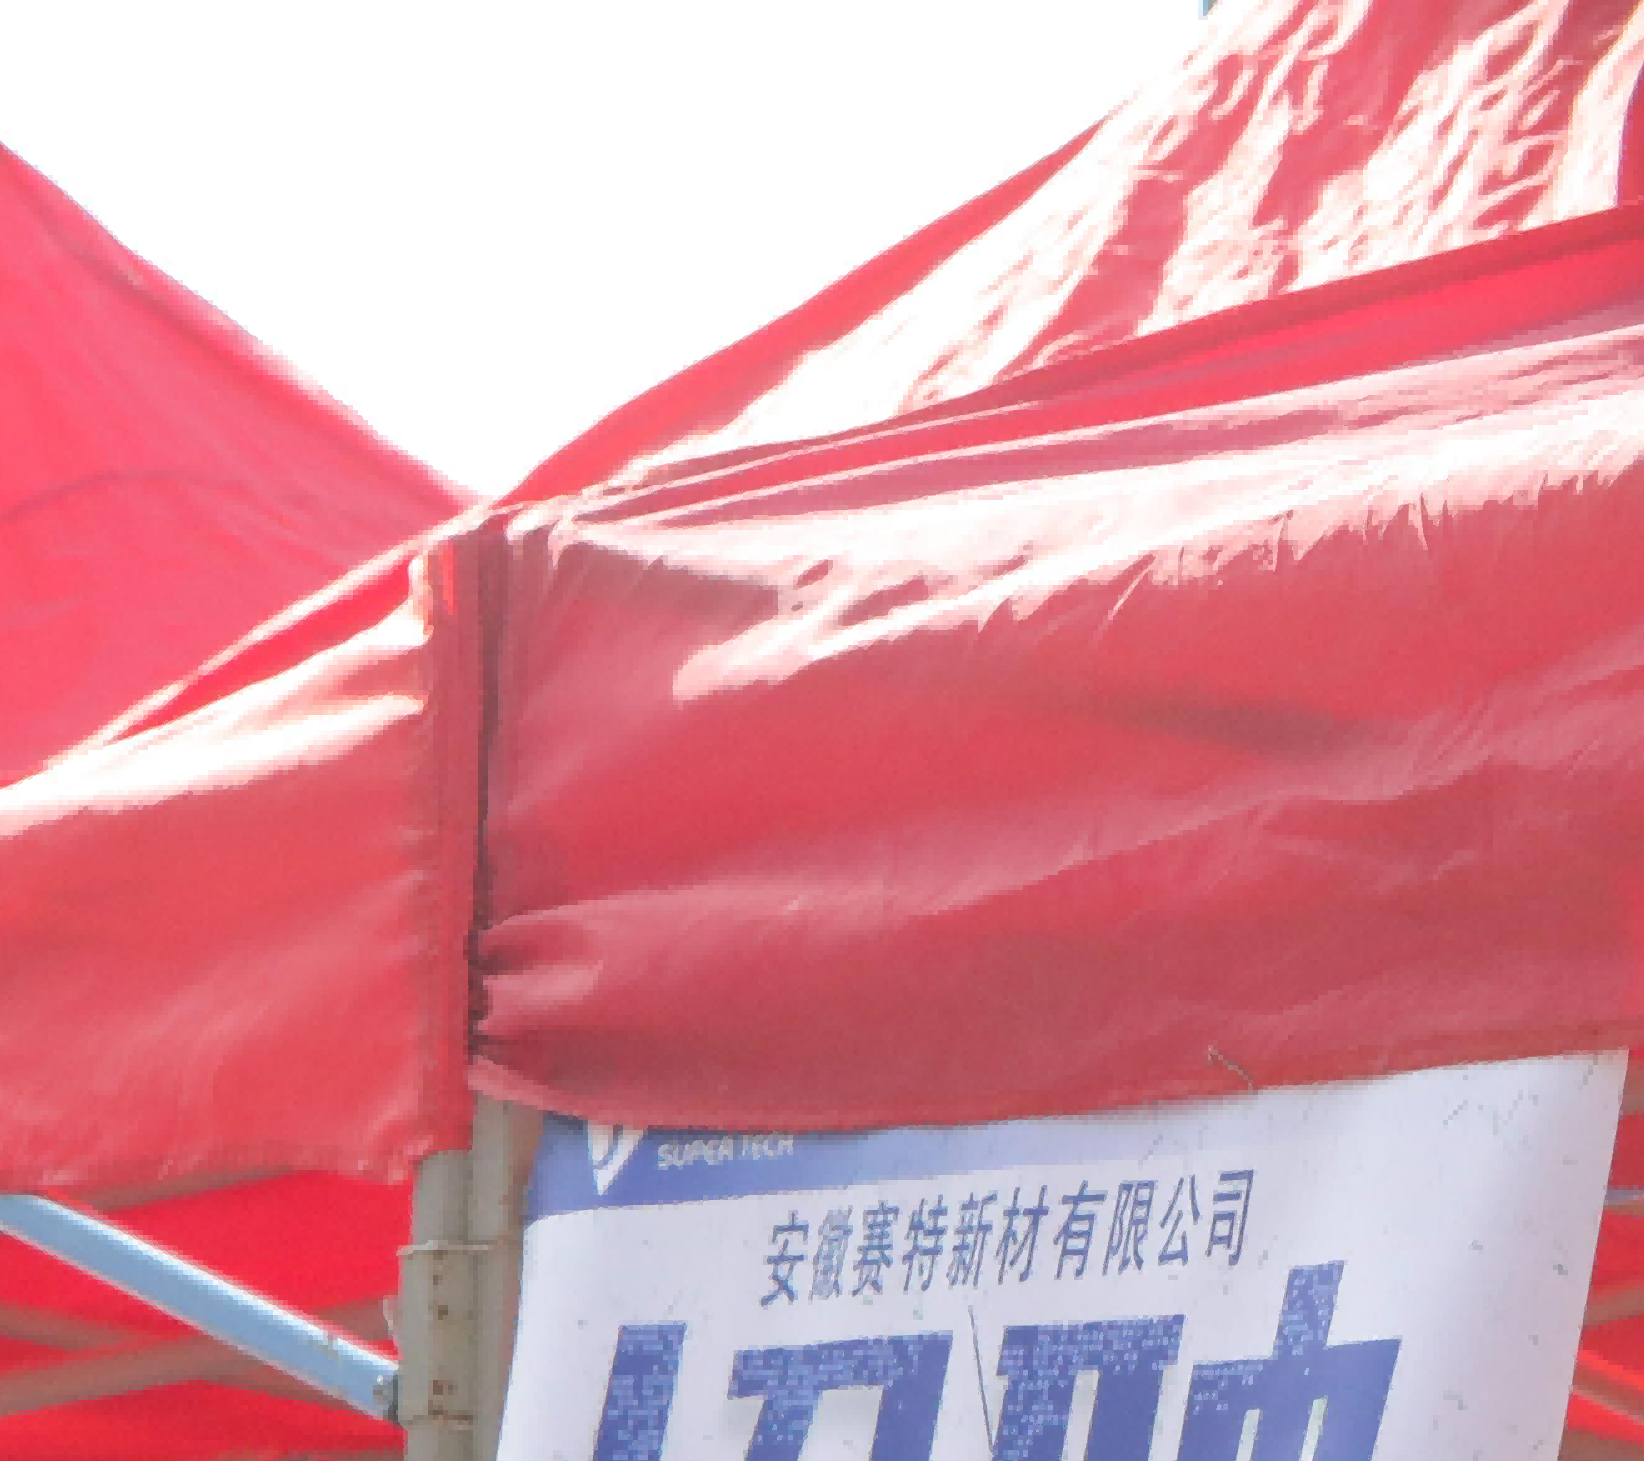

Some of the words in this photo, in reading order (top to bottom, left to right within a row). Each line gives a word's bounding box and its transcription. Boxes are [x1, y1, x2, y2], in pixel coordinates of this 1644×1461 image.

[760, 1168, 1255, 1308] 安徽赛特新材有限公司
